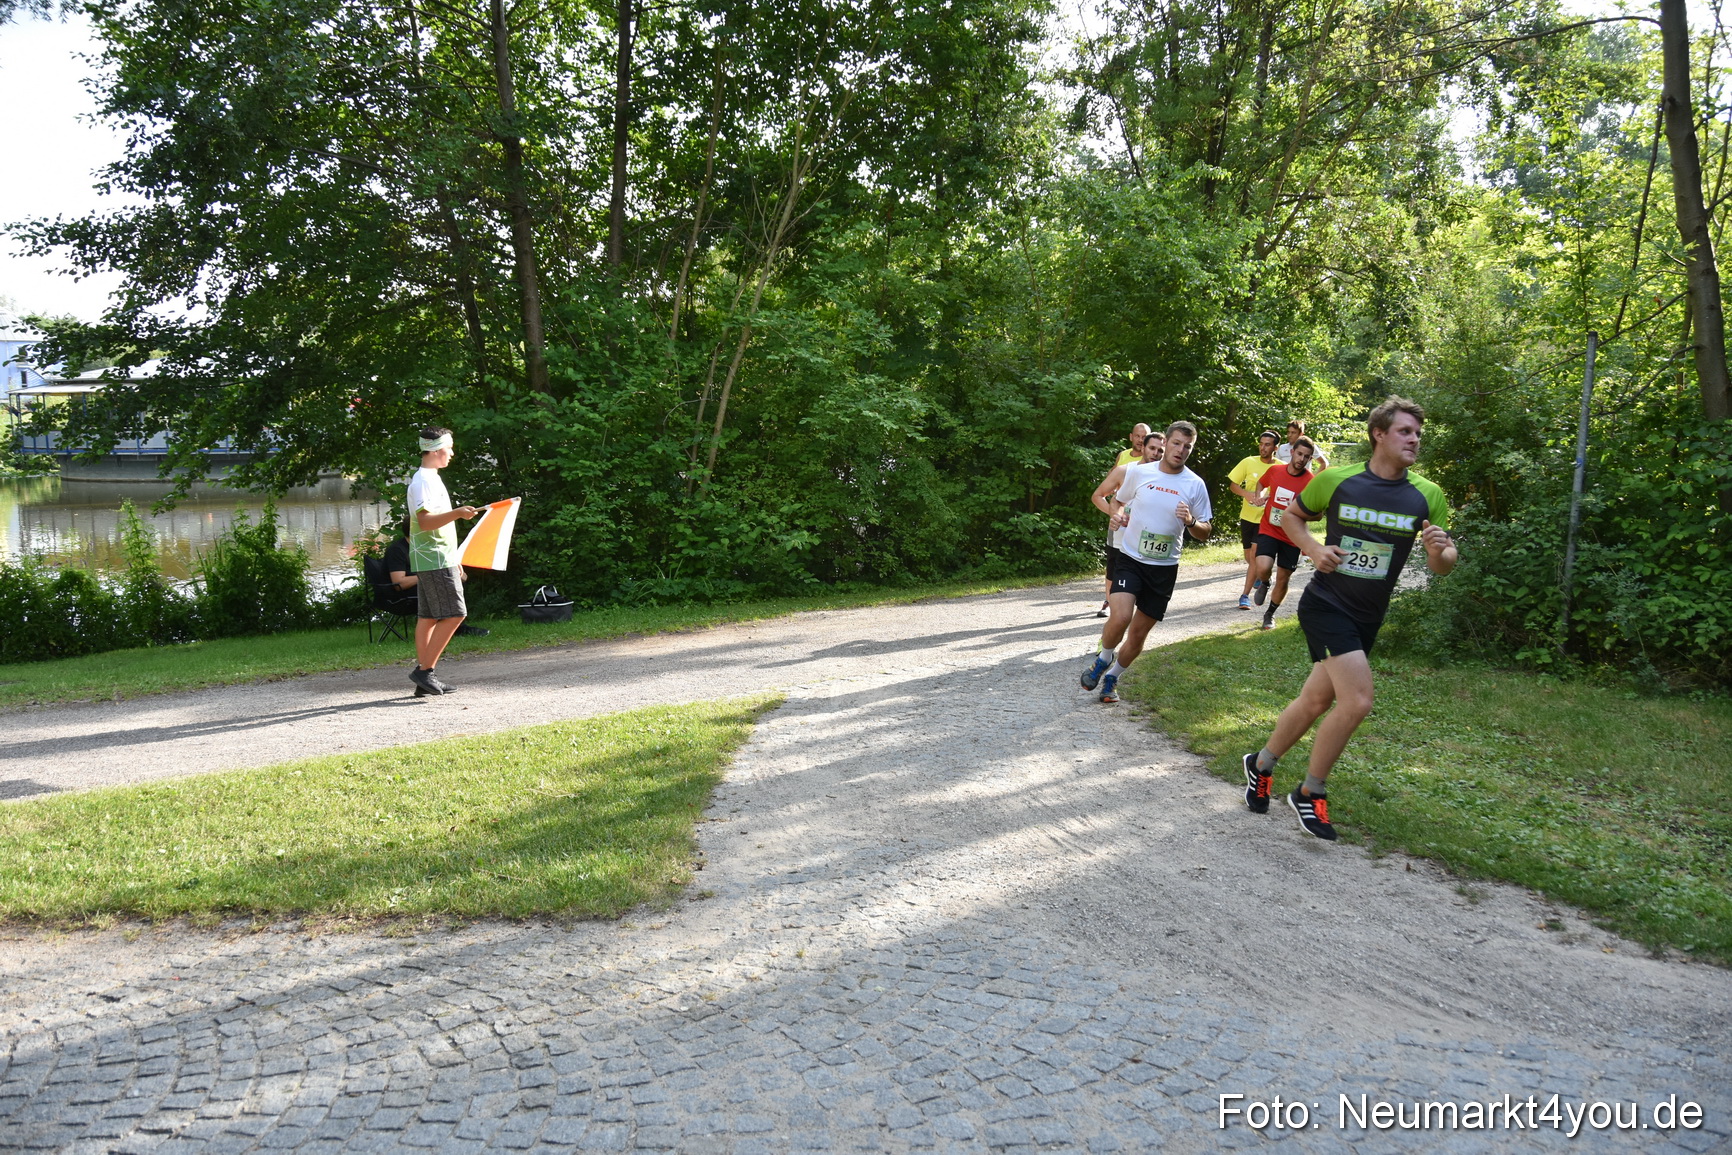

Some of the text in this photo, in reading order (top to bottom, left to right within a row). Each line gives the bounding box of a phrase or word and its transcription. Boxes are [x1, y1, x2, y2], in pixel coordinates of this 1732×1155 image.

[1156, 486, 1180, 496] KLEBL
[1339, 504, 1417, 530] BOCK
[1143, 540, 1168, 552] 1148
[1347, 552, 1379, 569] 293
